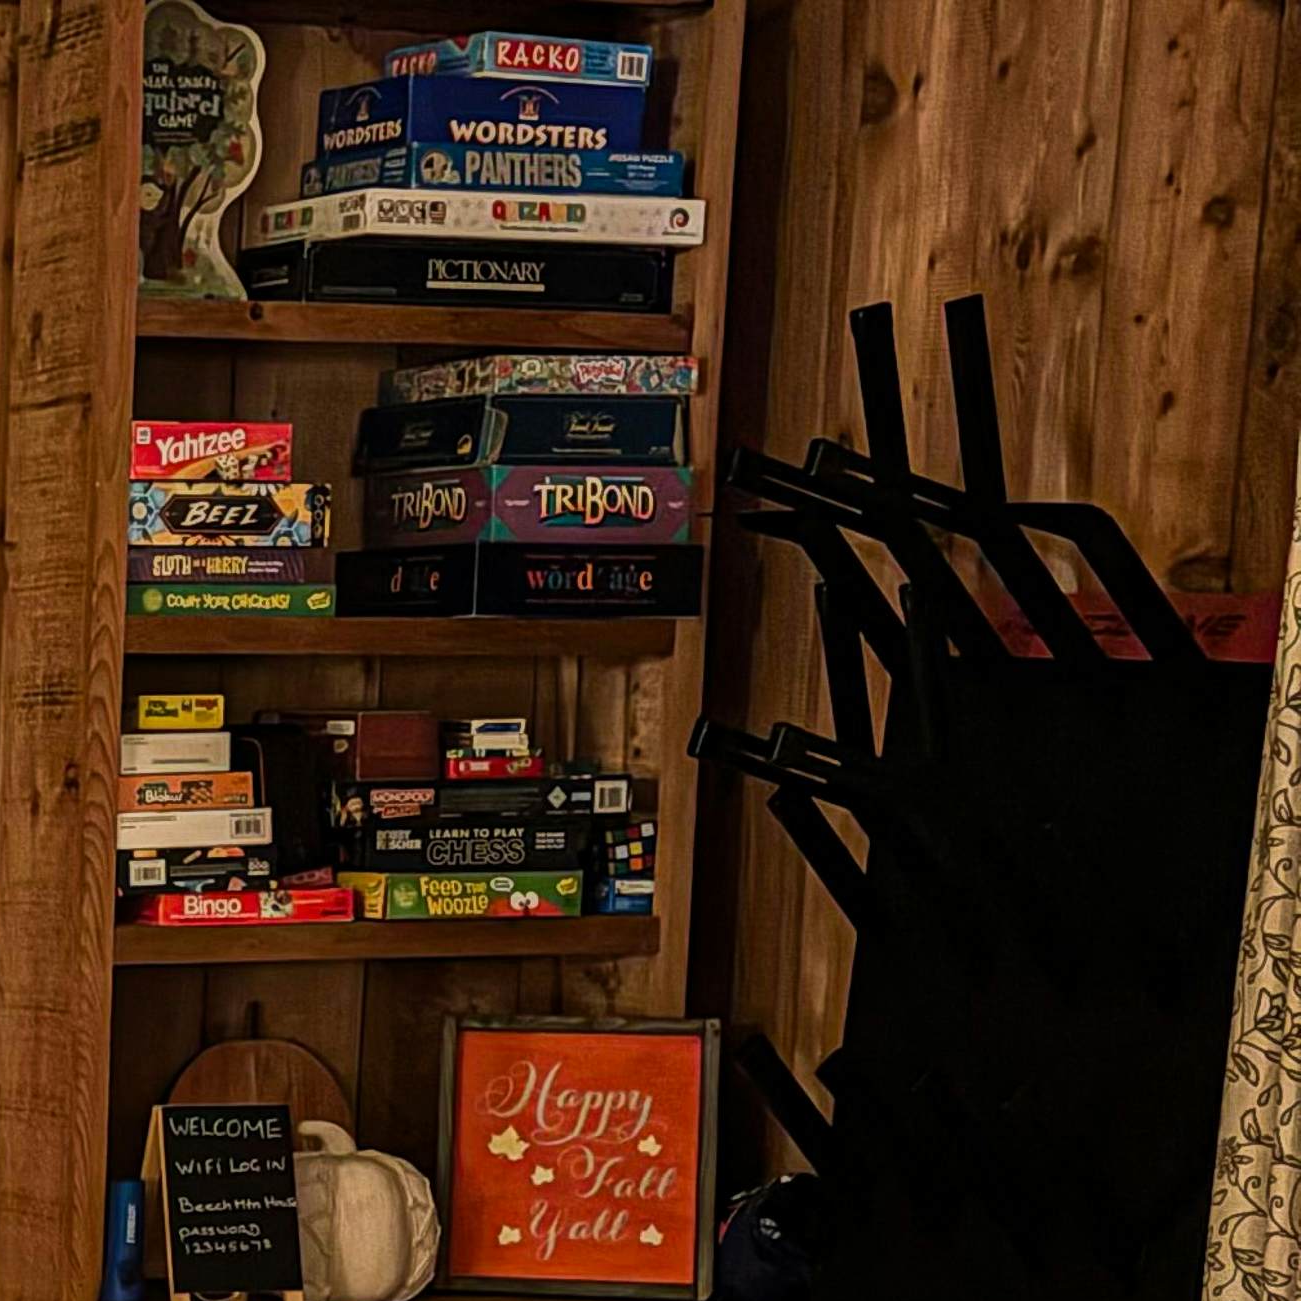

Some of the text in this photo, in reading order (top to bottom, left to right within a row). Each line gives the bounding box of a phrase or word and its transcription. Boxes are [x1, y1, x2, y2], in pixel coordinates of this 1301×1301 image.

[323, 118, 402, 151] WORDSTERS
[450, 119, 608, 151] WORDSTERS
[464, 150, 582, 188] PANTHERS
[427, 257, 545, 284] PICTIONARY
[155, 428, 246, 466] Yahtzee
[180, 501, 259, 527] BEEZ
[429, 827, 525, 839] LEARN TO PLAY
[426, 839, 525, 866] CHESS
[183, 894, 243, 917] Bingo
[486, 1060, 659, 1146] Happy
[169, 1116, 283, 1140] WELCOME
[229, 1157, 261, 1174] LOG
[556, 1144, 678, 1200] Fall
[177, 1196, 232, 1214] Beech
[184, 1238, 272, 1255] 12345678
